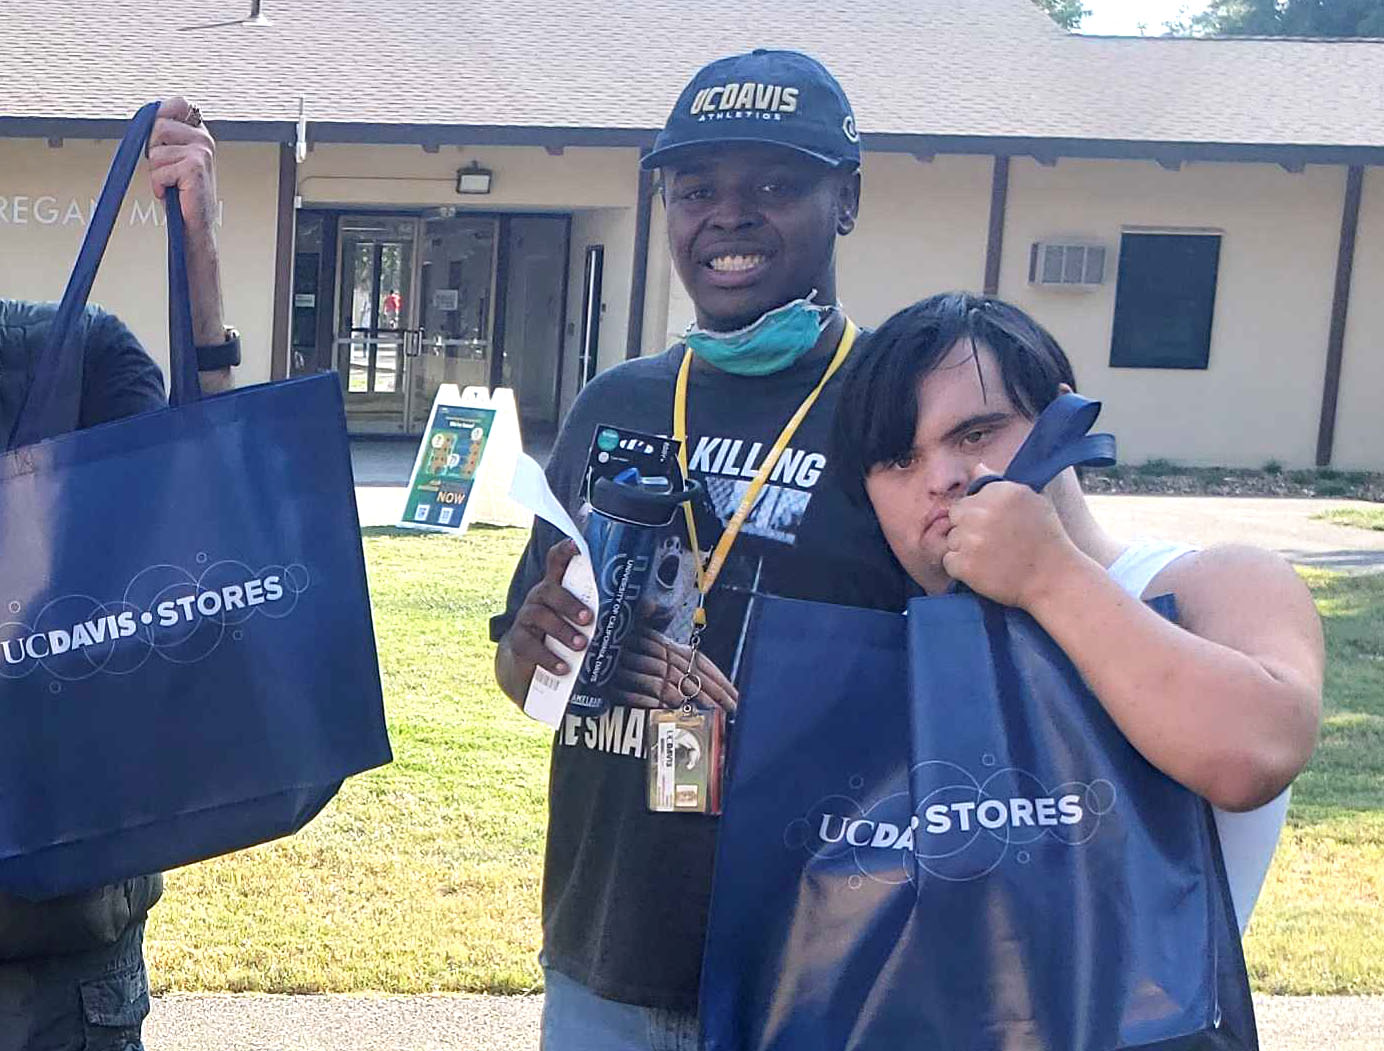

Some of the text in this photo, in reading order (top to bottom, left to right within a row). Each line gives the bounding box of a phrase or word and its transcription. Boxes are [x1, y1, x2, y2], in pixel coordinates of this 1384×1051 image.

[698, 111, 781, 123] ATHLETICS
[129, 198, 224, 228] MN
[688, 436, 827, 488] KILLNG
[437, 492, 466, 504] NOW
[616, 560, 634, 602] UNIVERSITY
[157, 575, 284, 627] STORES
[612, 604, 620, 615] OF
[590, 661, 603, 682] DAVIS
[818, 794, 1084, 851] UCDA STORES
